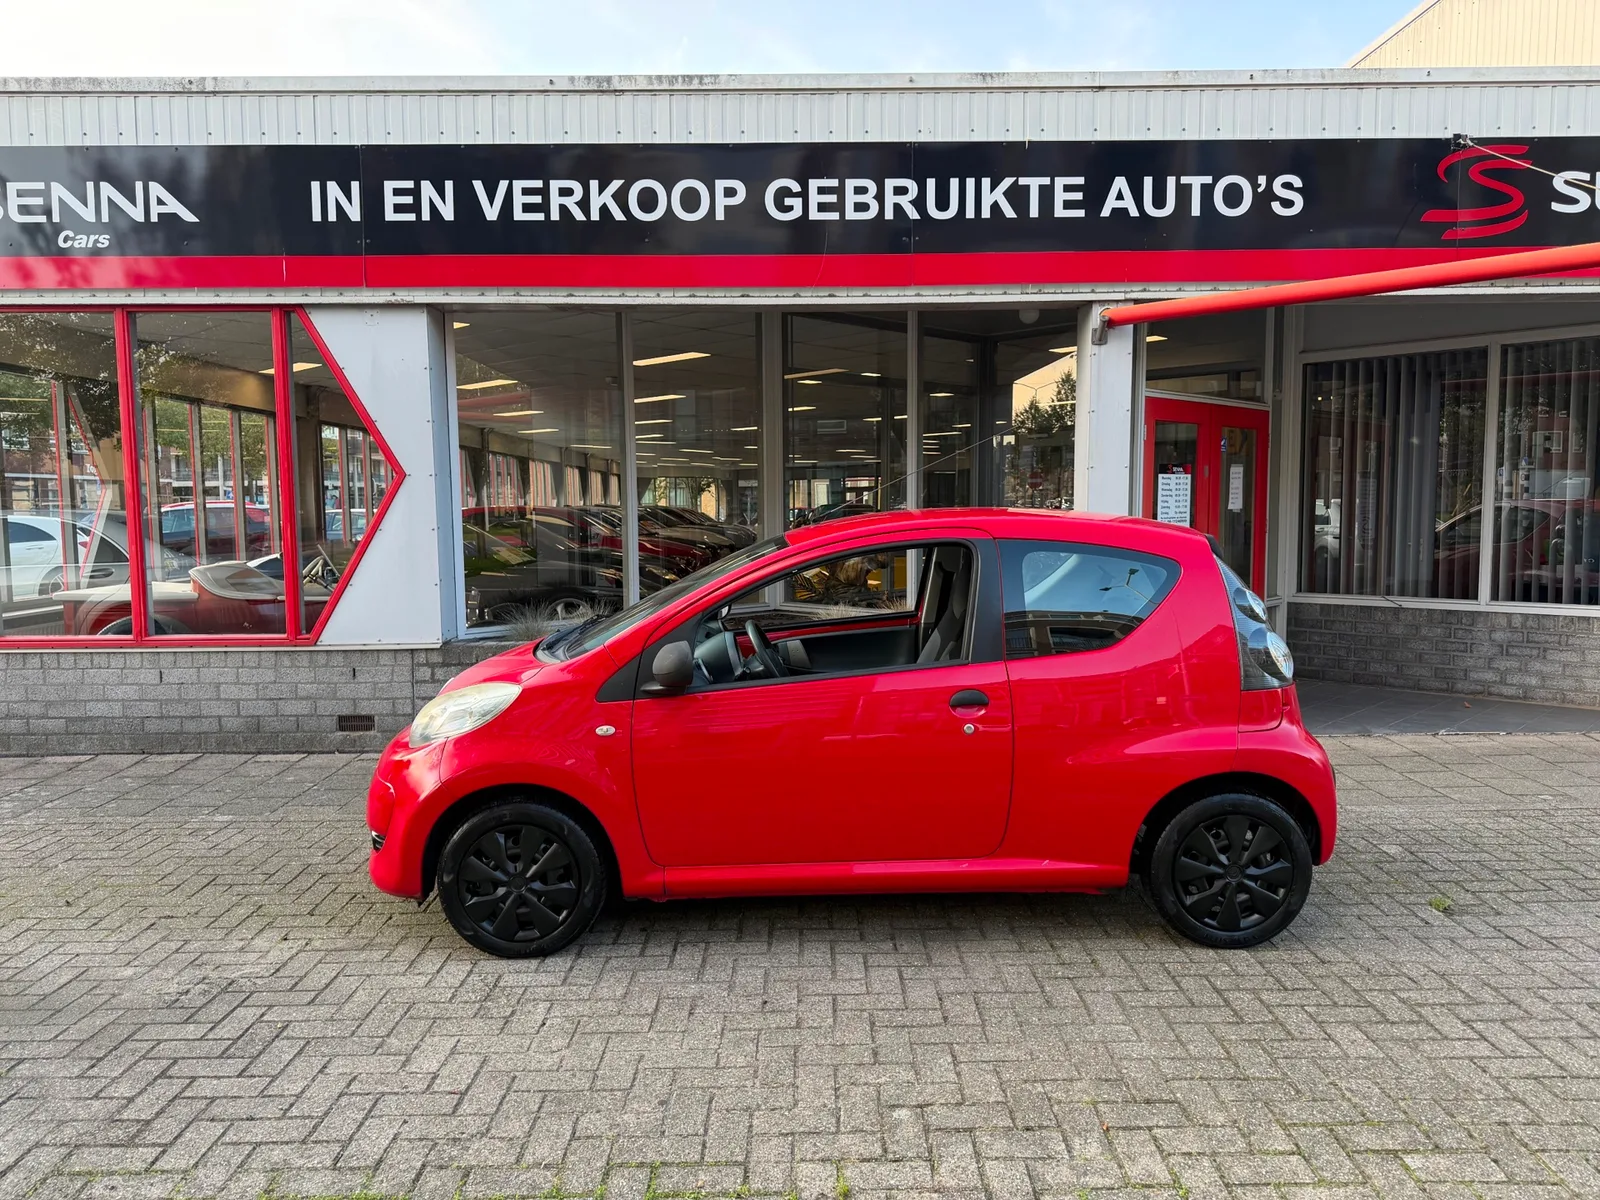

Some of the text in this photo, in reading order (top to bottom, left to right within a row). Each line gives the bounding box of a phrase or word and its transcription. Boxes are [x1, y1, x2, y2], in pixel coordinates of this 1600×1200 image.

[0, 181, 200, 222] ENNA
[311, 180, 361, 222] IN
[384, 180, 454, 222] EN
[472, 179, 747, 222] VERKOOP
[764, 176, 1086, 221] GEBRUIKTE
[1551, 171, 1600, 213] S
[57, 230, 110, 248] Cars
